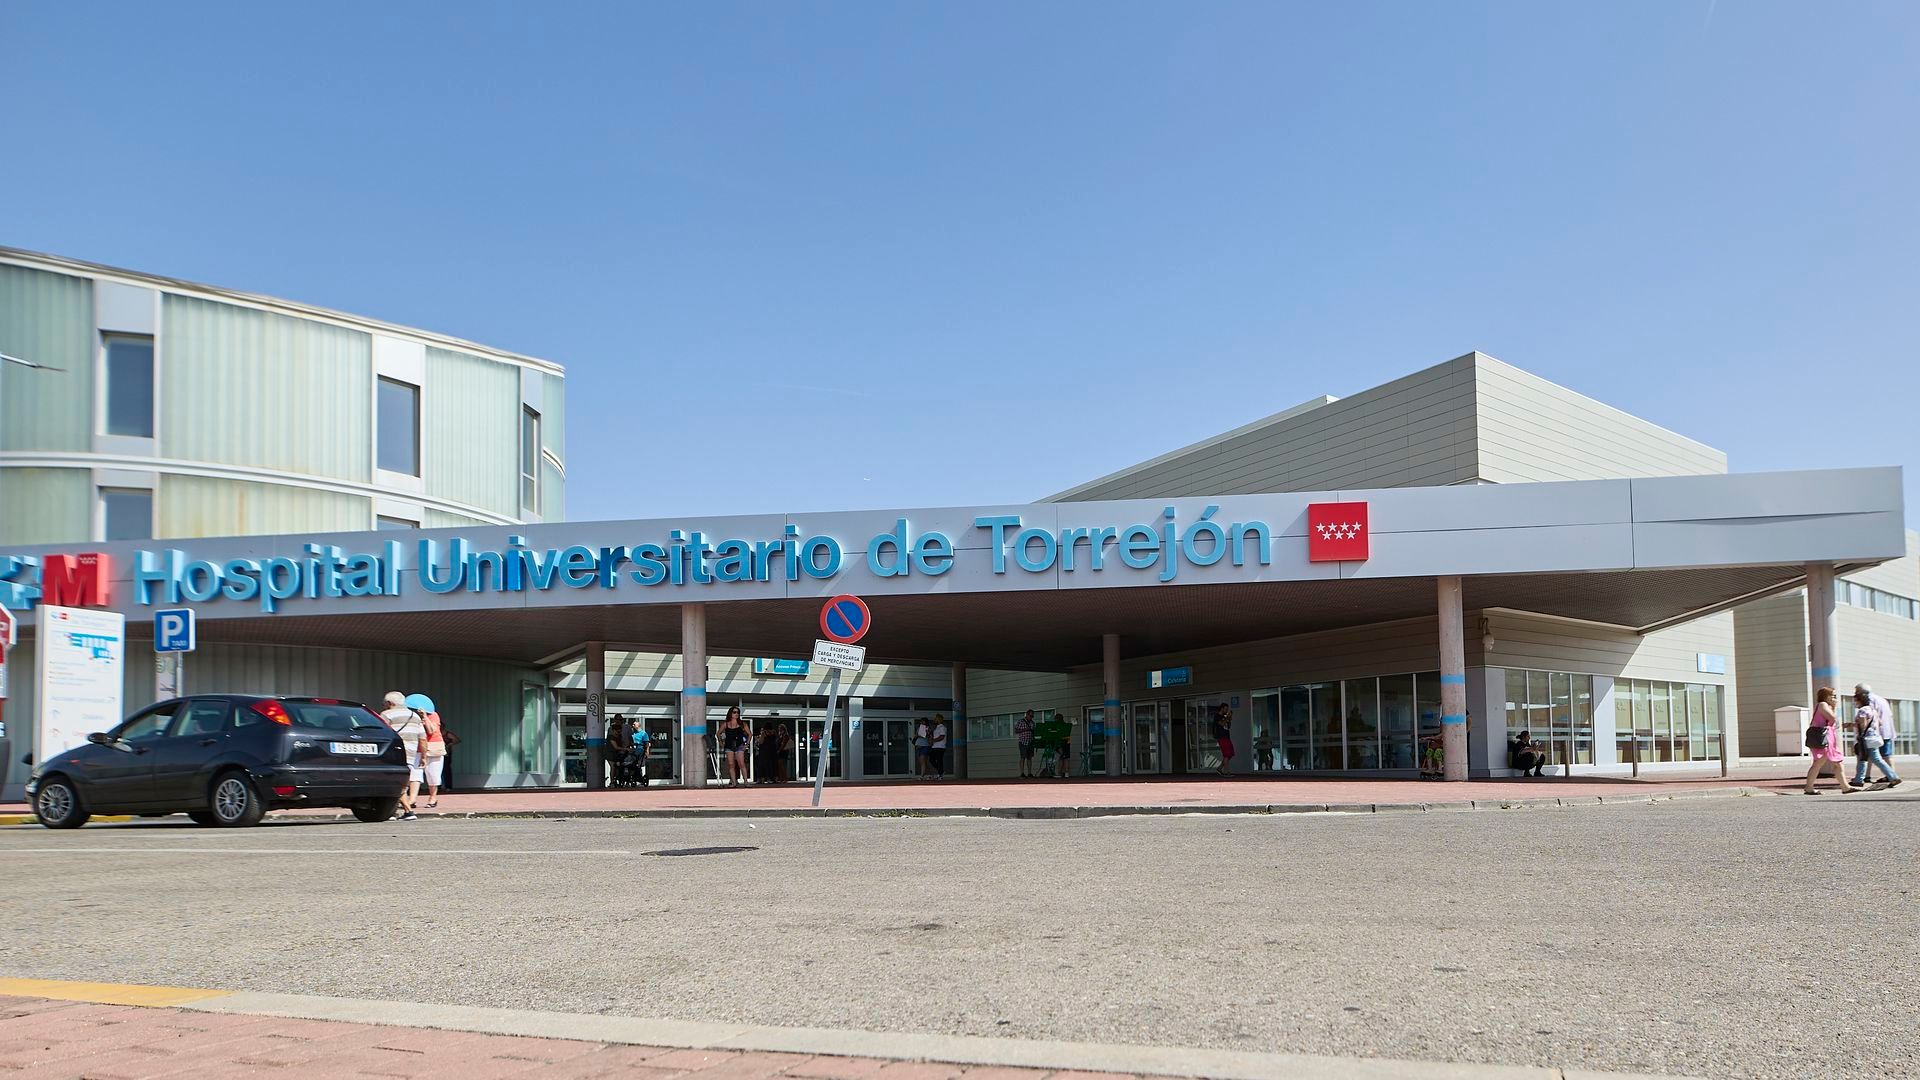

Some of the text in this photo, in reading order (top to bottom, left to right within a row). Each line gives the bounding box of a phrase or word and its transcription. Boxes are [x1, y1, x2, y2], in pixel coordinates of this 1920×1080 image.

[134, 504, 1272, 613] Hospital Universitario de Torrejón
[161, 614, 184, 648] P
[830, 646, 850, 654] EXCEPTO
[837, 653, 860, 662] DESCARGA
